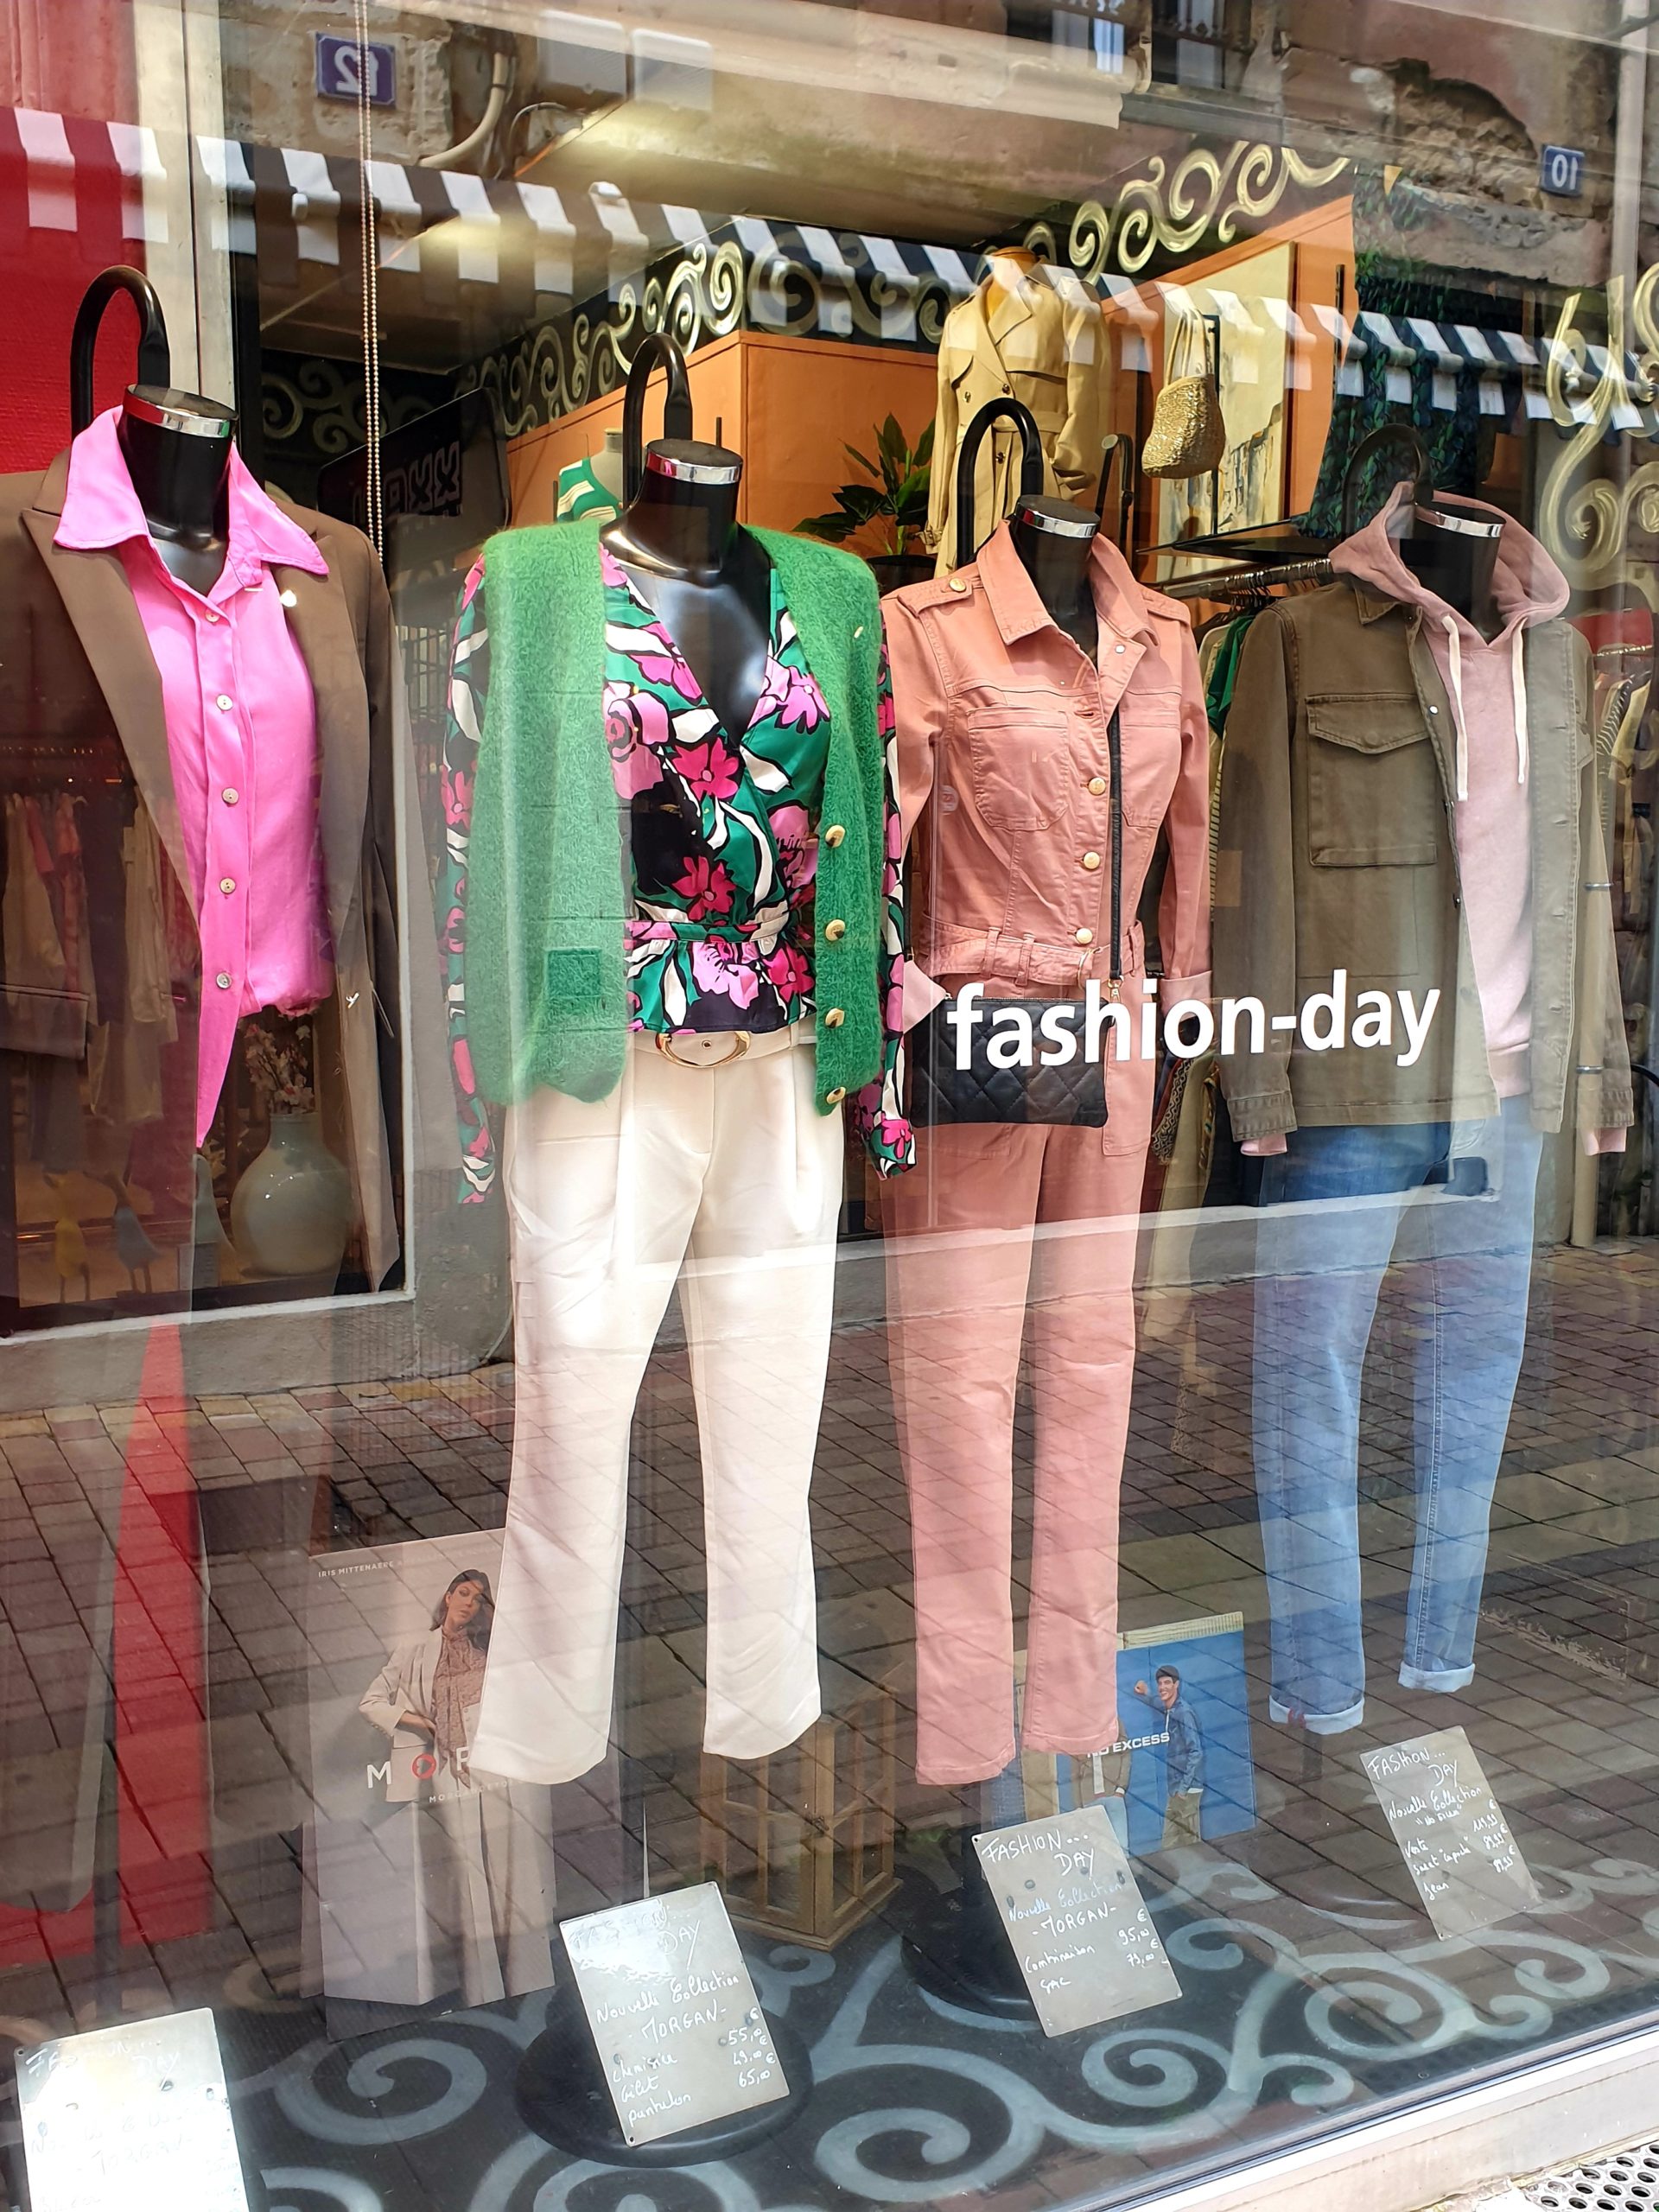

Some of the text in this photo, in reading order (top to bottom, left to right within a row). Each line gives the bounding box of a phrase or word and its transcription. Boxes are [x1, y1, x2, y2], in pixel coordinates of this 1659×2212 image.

[947, 969, 1440, 1071] fashion-day
[318, 1569, 336, 1578] IRIS
[1112, 1732, 1170, 1753] EXCESS
[1427, 1759, 1458, 1788] DAY
[1054, 1847, 1095, 1880] DAY
[658, 1919, 701, 1971] DAY
